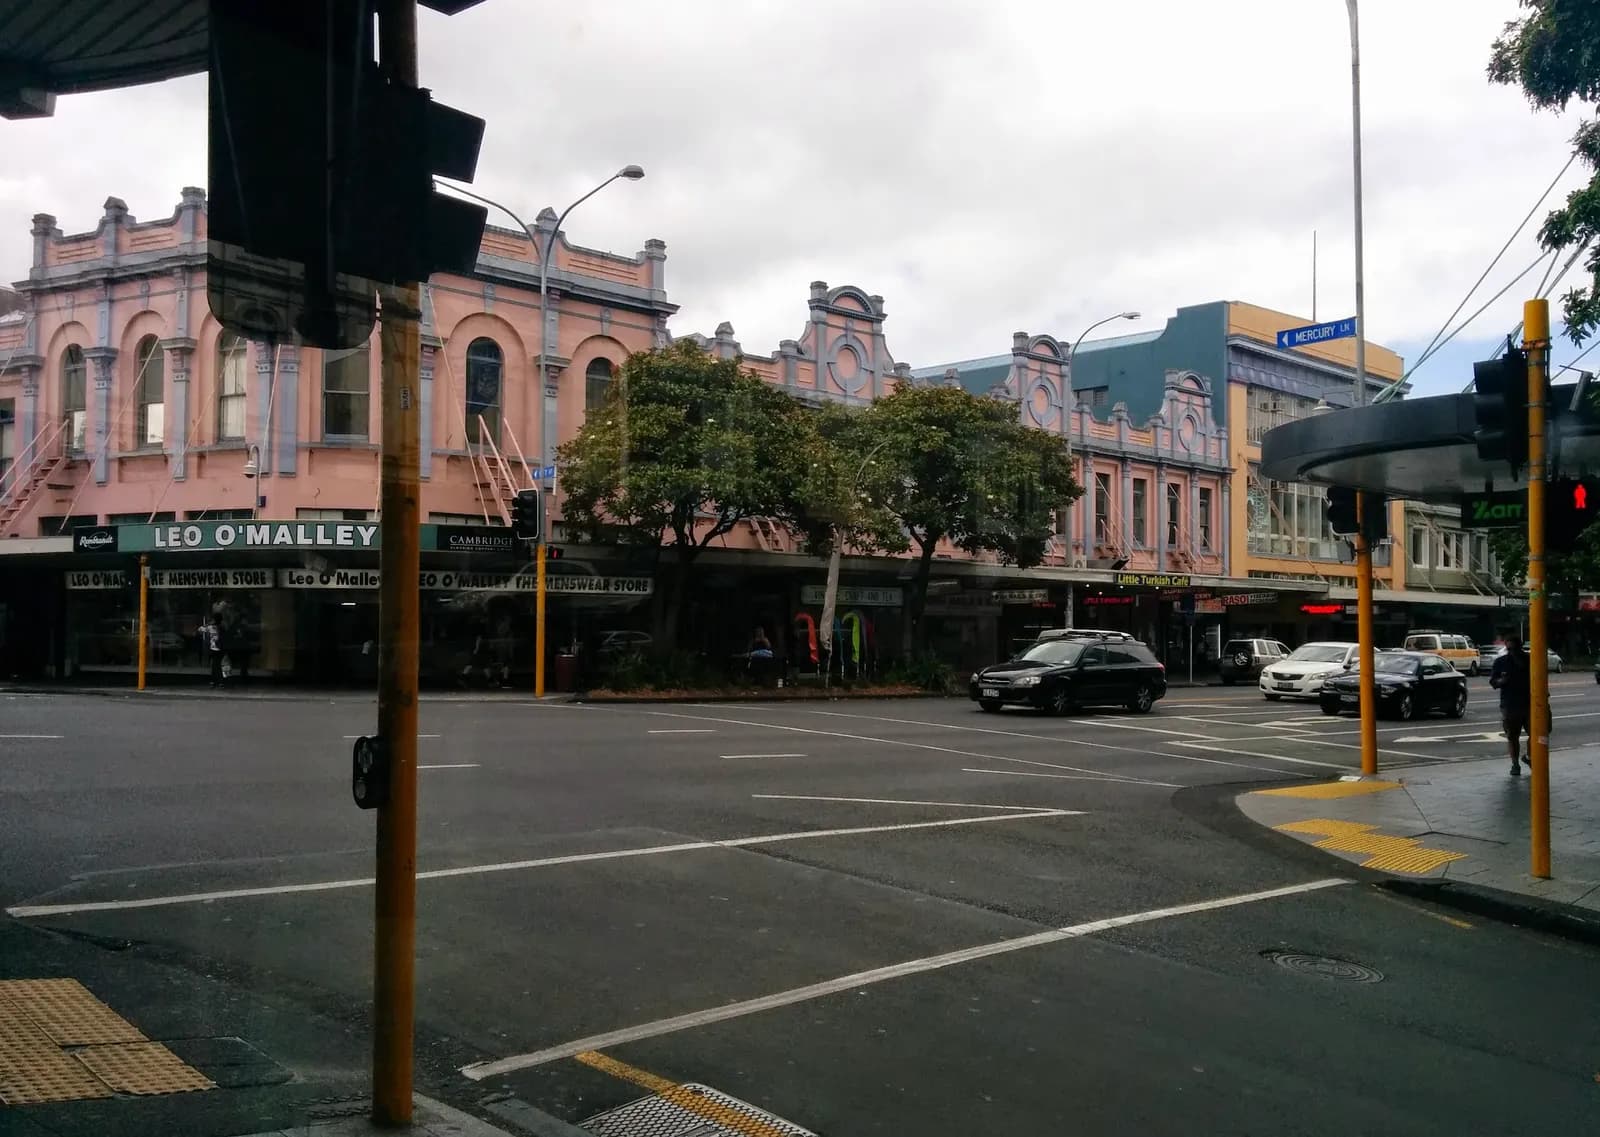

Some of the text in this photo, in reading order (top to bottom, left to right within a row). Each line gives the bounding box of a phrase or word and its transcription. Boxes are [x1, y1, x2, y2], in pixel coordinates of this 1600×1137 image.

[1296, 323, 1350, 342] MERCURY LN
[155, 524, 378, 547] LEO O'MALLEY
[71, 574, 89, 586] LEO
[168, 572, 228, 586] MENSWEAR
[232, 571, 266, 585] STORE
[288, 571, 314, 585] Leo
[614, 578, 648, 592] STORE
[1118, 574, 1140, 584] Little
[1141, 575, 1170, 585] Turkish
